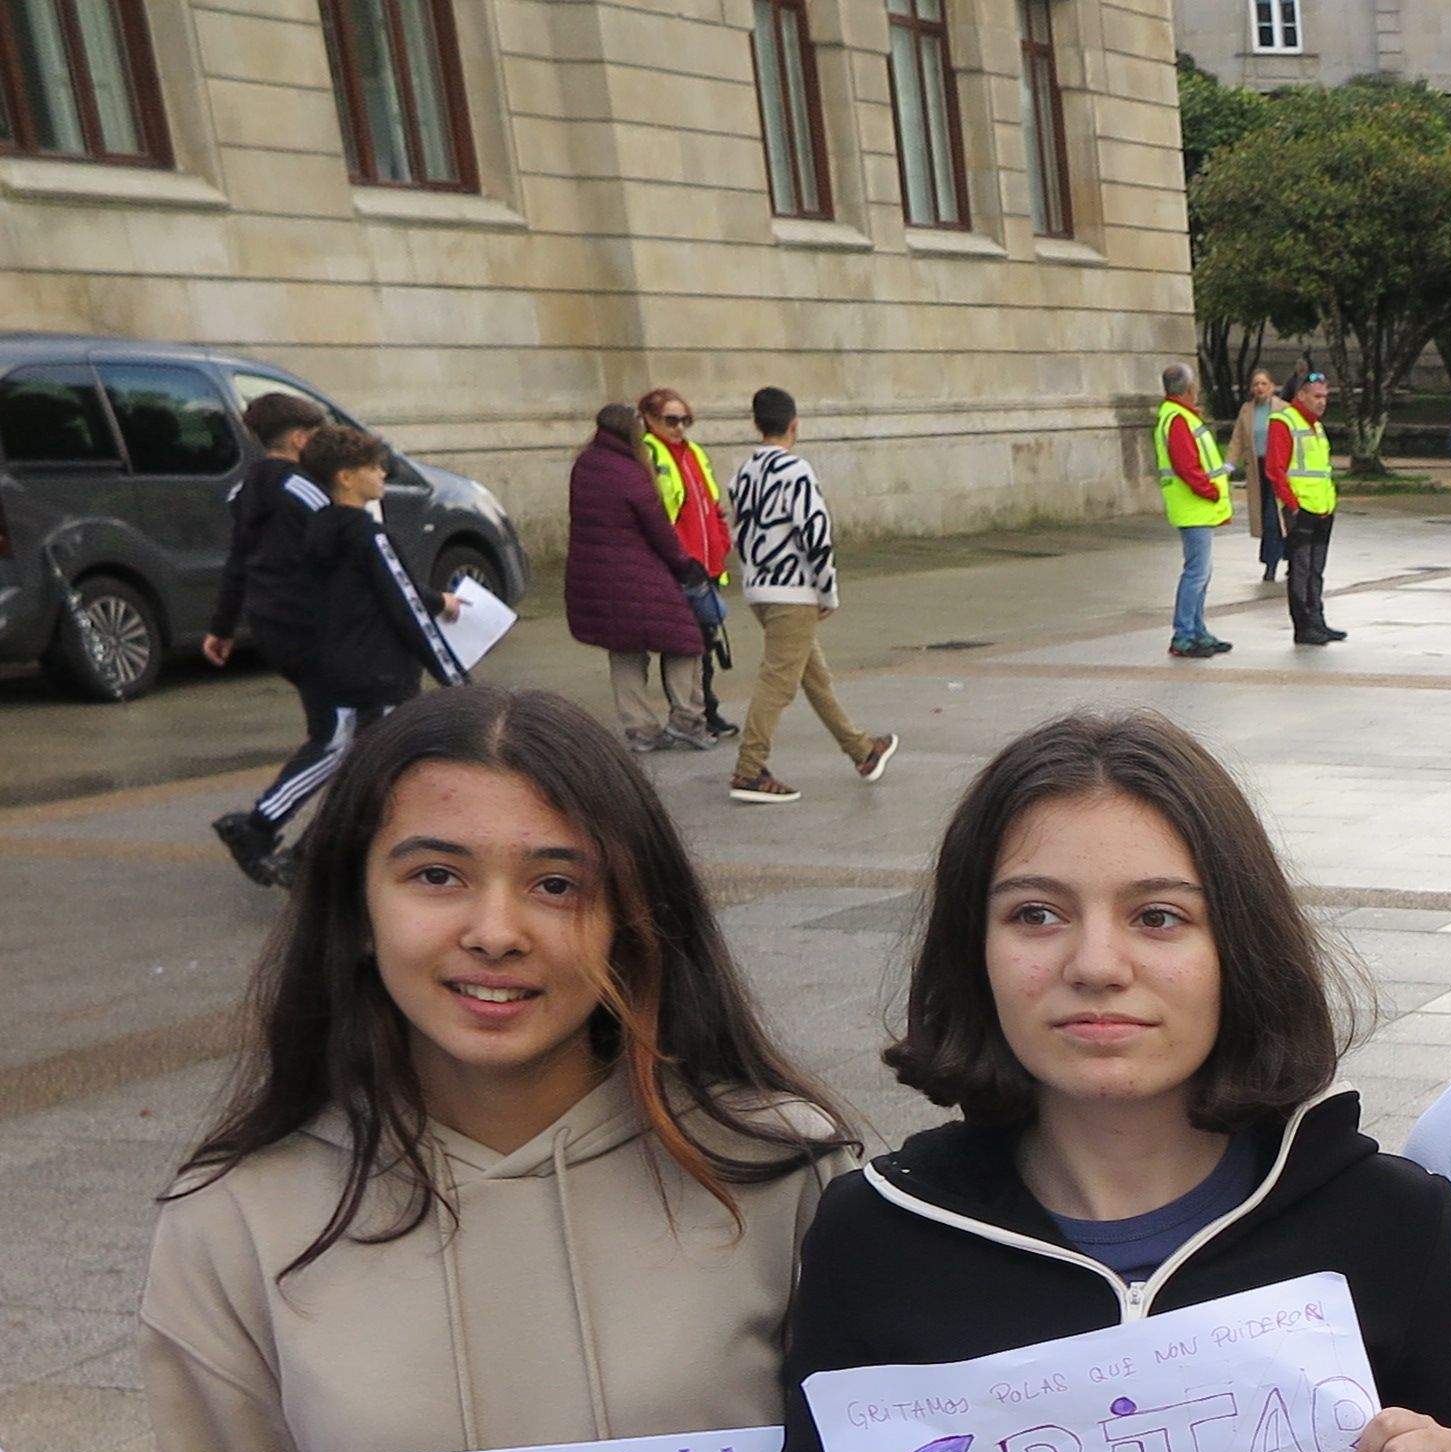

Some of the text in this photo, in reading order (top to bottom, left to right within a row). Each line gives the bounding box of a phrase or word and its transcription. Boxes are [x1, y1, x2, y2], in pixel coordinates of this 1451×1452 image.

[989, 1372, 1070, 1406] POLAS
[1090, 1357, 1136, 1384] QUE
[1155, 1336, 1198, 1364] NON
